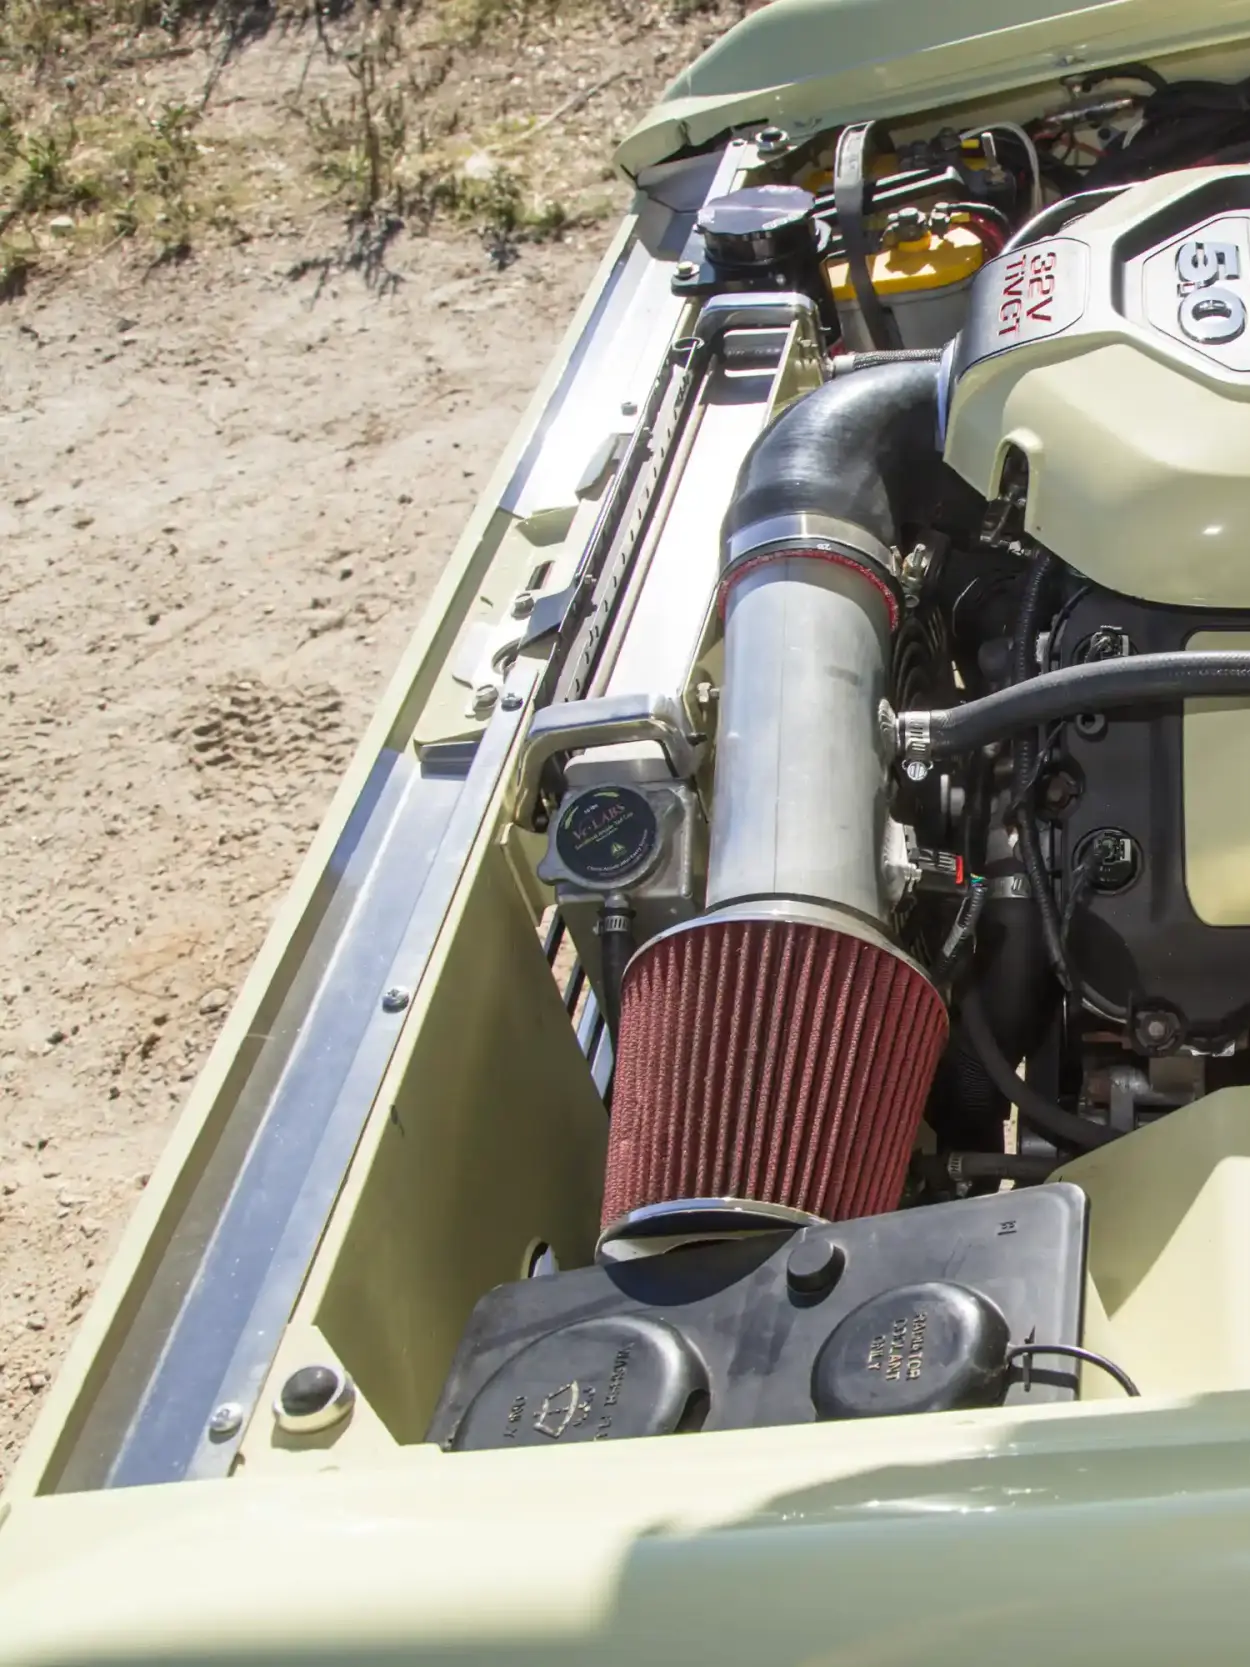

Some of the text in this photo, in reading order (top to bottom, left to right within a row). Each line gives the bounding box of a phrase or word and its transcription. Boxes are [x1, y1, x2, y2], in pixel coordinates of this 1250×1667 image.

[1026, 251, 1057, 322] 32V
[1174, 241, 1248, 346] 5.0
[867, 1334, 886, 1371] ONLY
[886, 1318, 907, 1381] COOLANT
[906, 1312, 928, 1381] RADIATOR
